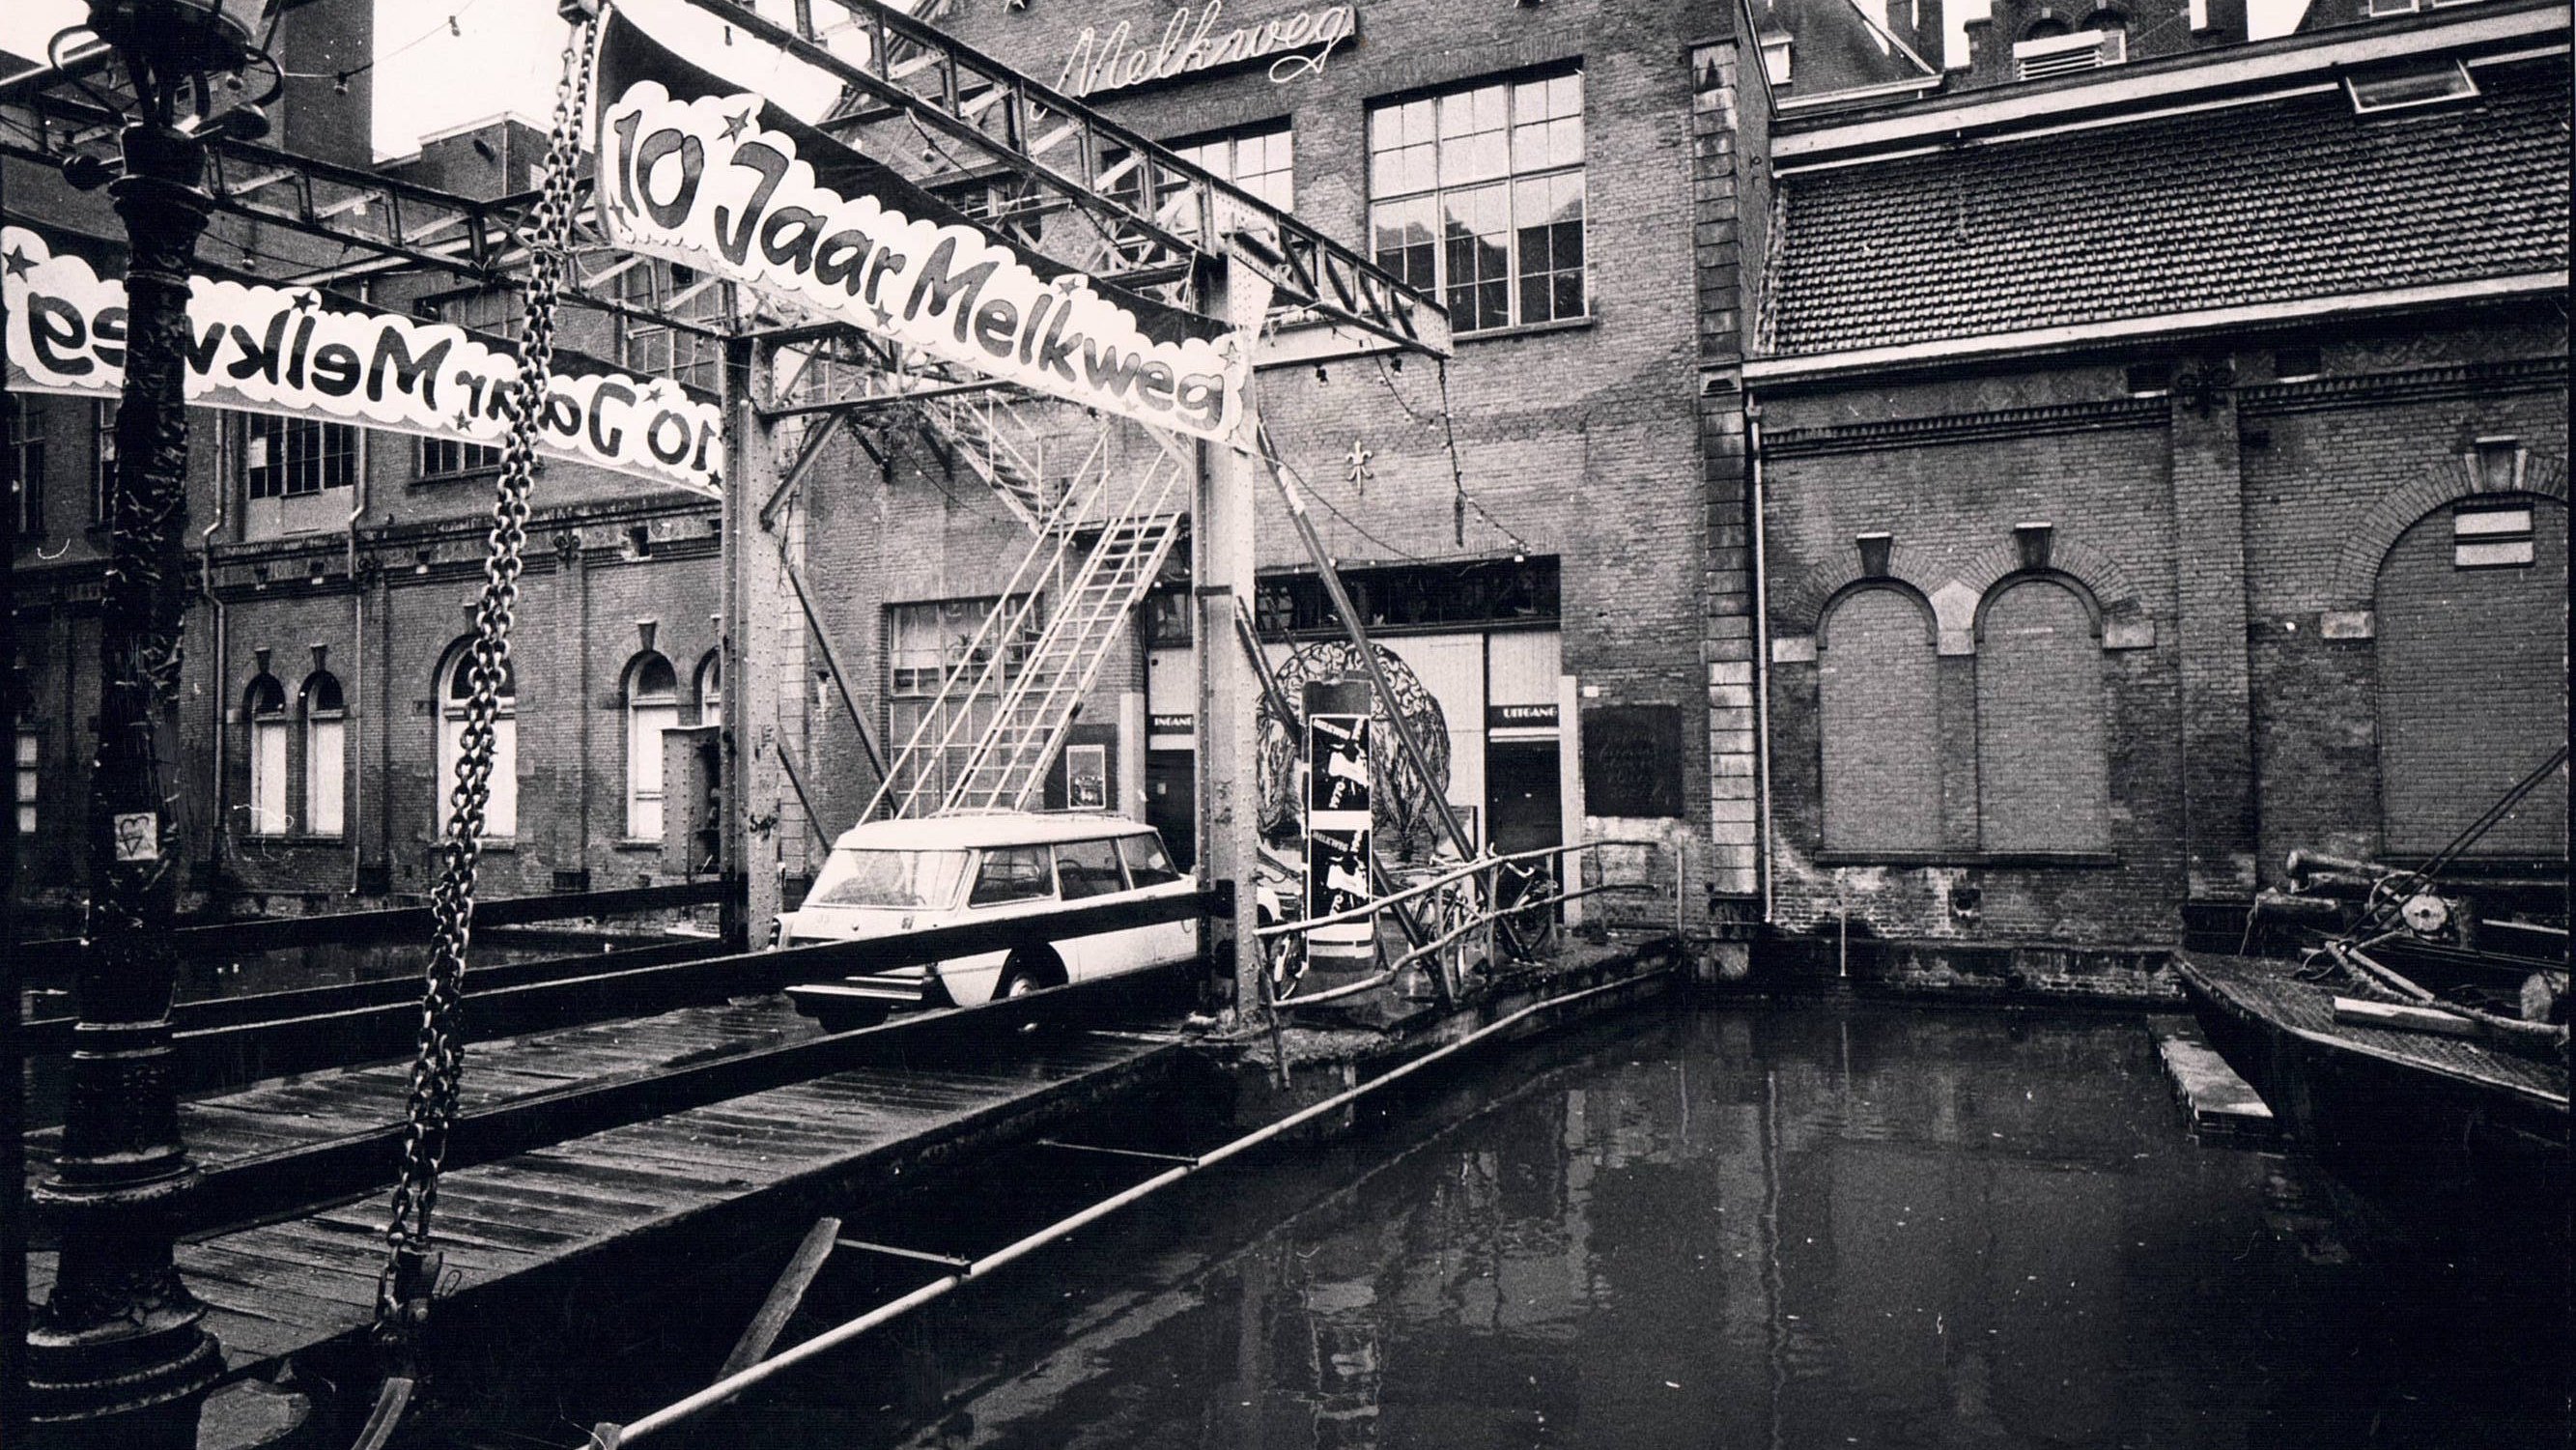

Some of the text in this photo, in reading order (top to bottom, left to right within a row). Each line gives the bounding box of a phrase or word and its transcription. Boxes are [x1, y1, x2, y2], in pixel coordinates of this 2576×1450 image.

[1030, 0, 1354, 121] Melkweg
[614, 110, 1225, 431] 10 Jaar Melkweg
[1153, 717, 1193, 726] INGANG
[1502, 706, 1558, 719] UITGANG
